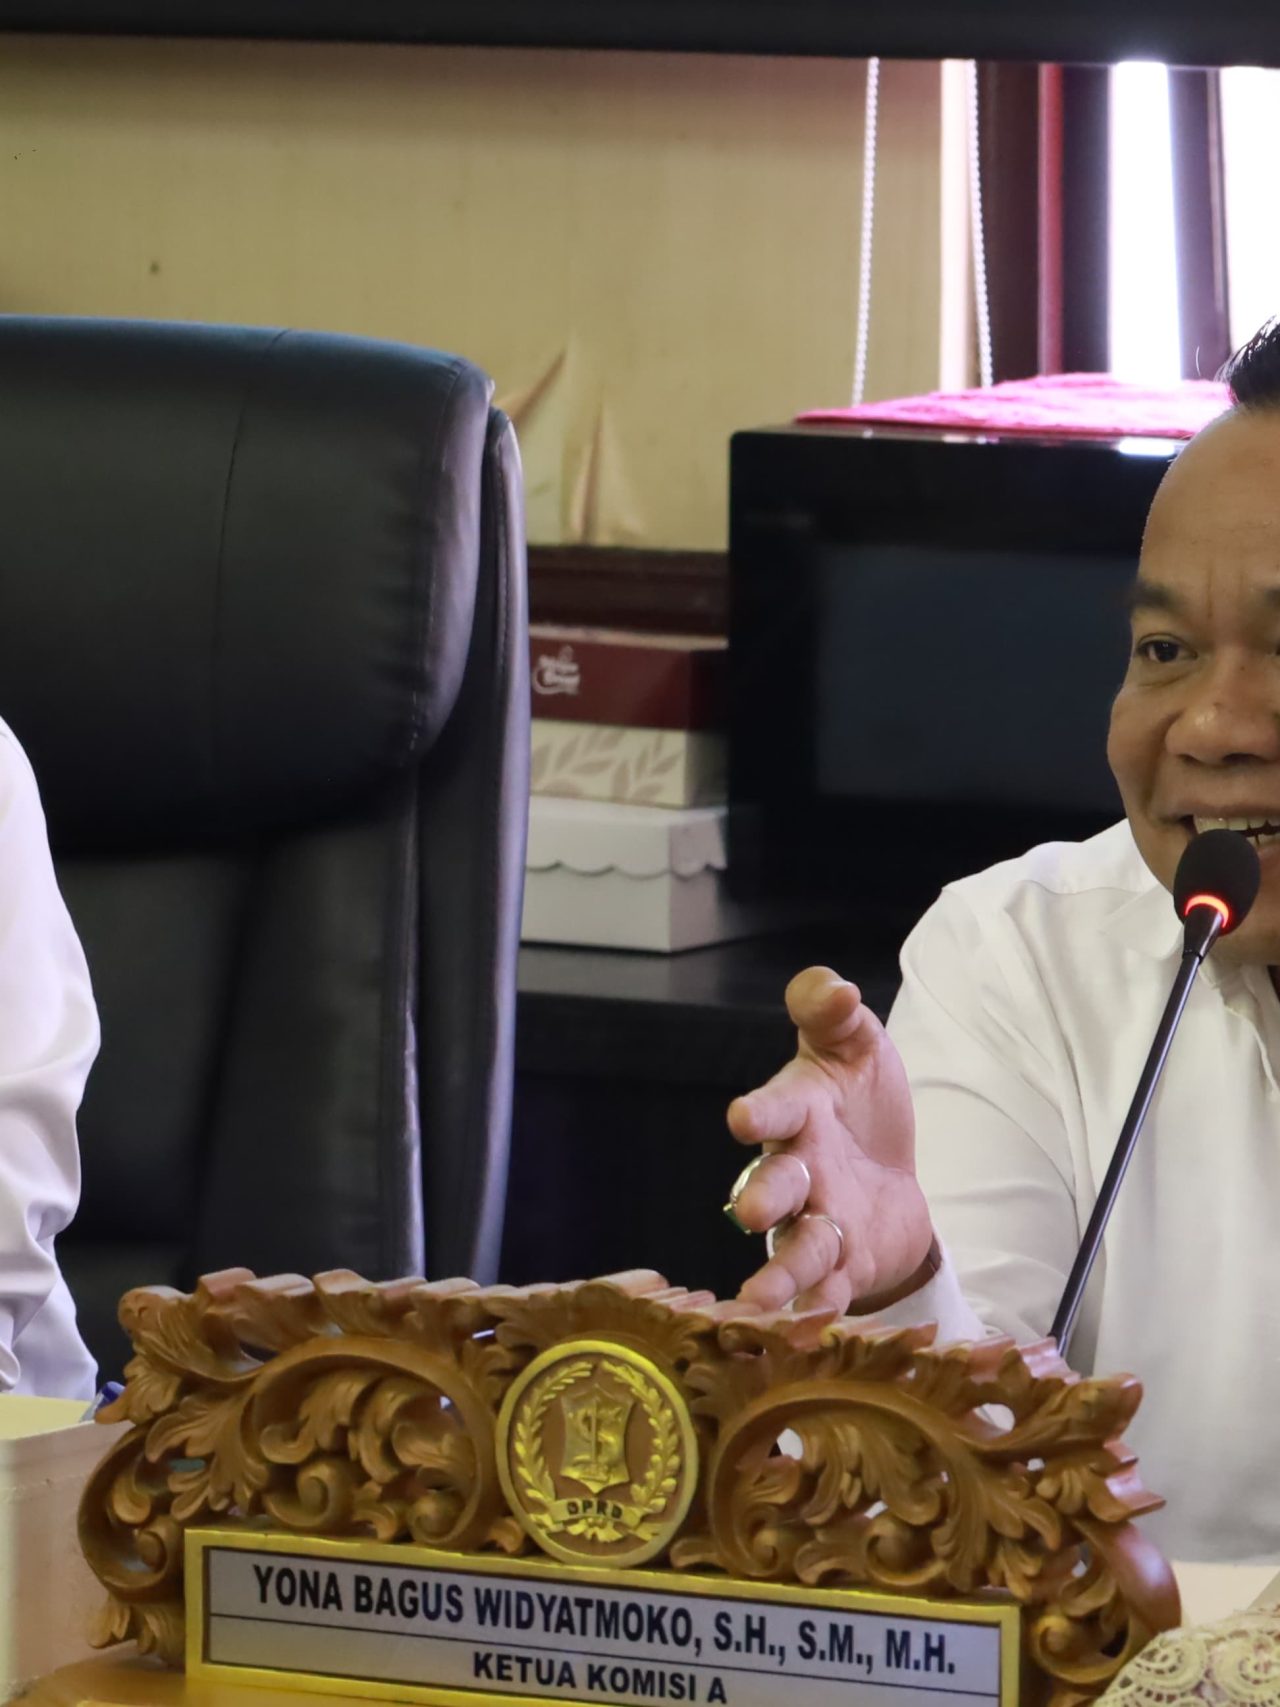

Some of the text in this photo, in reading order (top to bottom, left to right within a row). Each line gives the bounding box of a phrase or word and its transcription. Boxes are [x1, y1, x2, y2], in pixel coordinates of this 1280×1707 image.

[254, 1564, 955, 1674] YONA BAGUS WIDYATMOKO, S.H., S.M., M.H.
[473, 1652, 727, 1704] KETUA KOMISI A
